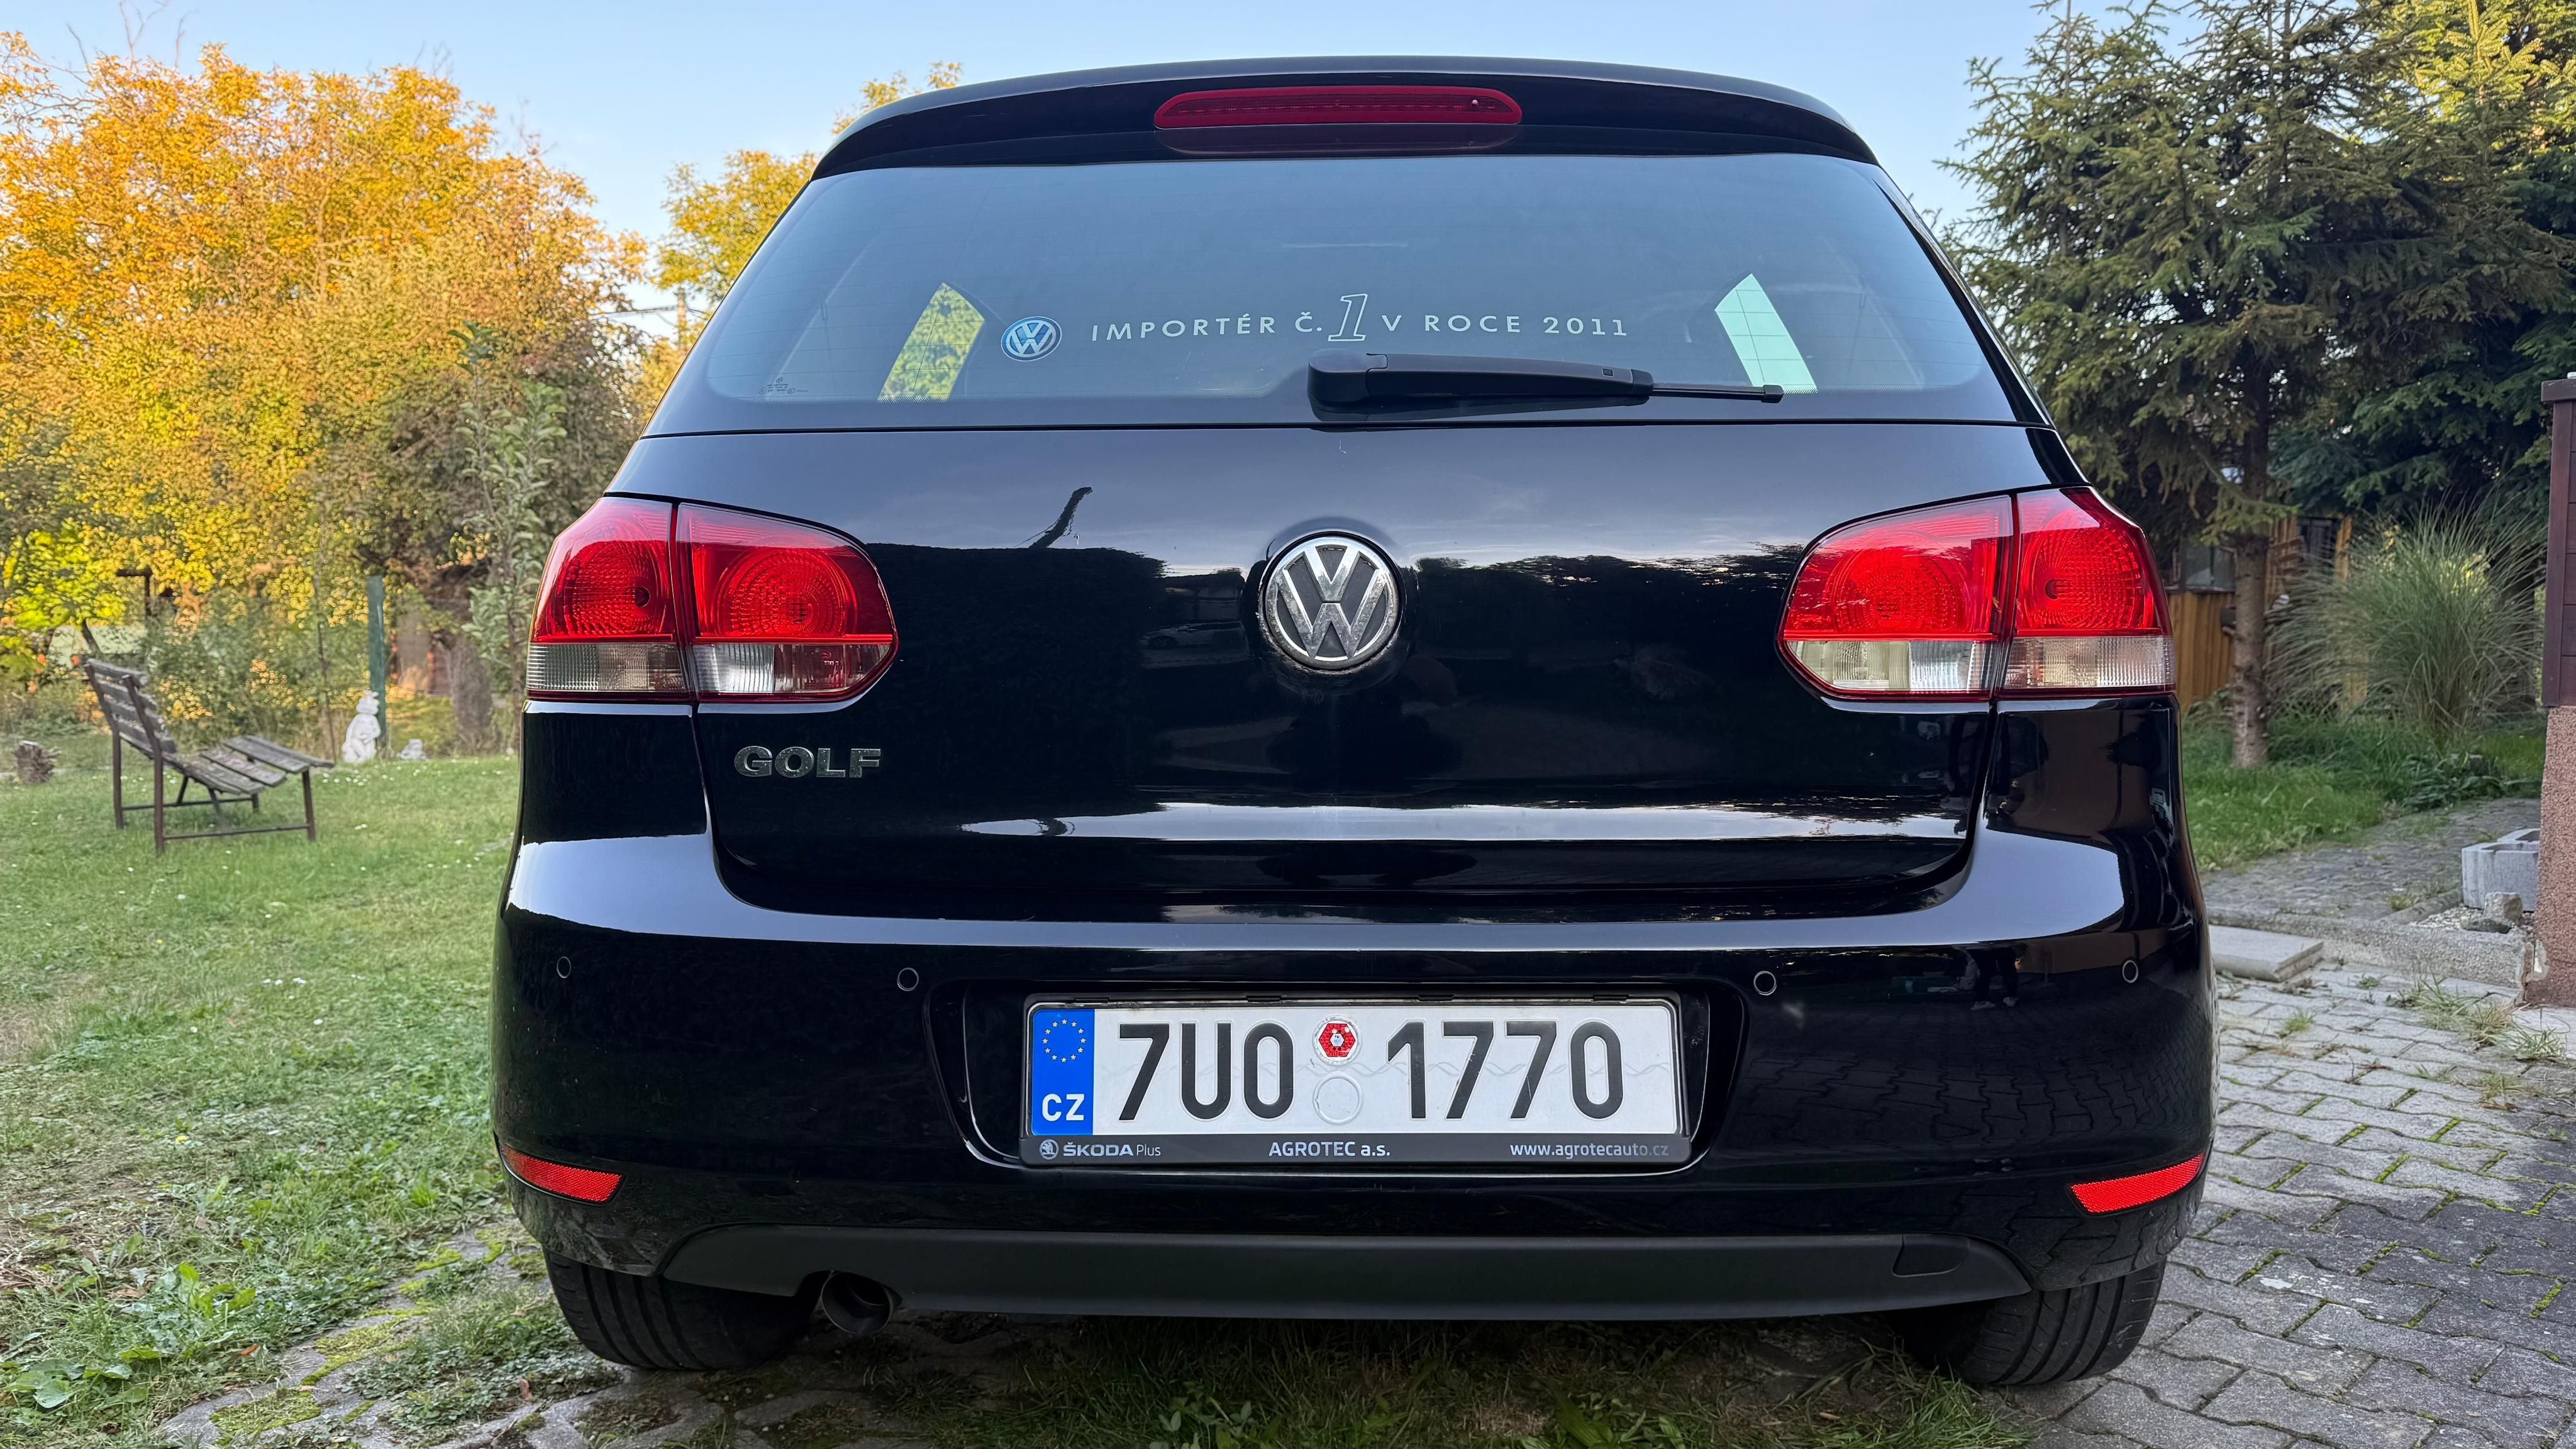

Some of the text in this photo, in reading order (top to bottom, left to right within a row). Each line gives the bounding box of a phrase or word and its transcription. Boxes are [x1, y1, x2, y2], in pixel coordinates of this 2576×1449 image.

[1005, 319, 1057, 358] VW
[1092, 313, 1275, 341] IMPORTÉR
[1381, 315, 1402, 331] V
[1424, 314, 1520, 333] ROCE
[1543, 316, 1627, 336] 2011
[1269, 537, 1394, 667] VW
[734, 745, 881, 779] GOLF
[1387, 1020, 1624, 1120] 1770
[1041, 1093, 1085, 1121] CZ
[1063, 1141, 1162, 1157] ŠKODA Plus
[1269, 1141, 1391, 1157] AGROTEC a.s.
[1509, 1142, 1669, 1159] www.agrotecauto.cz
